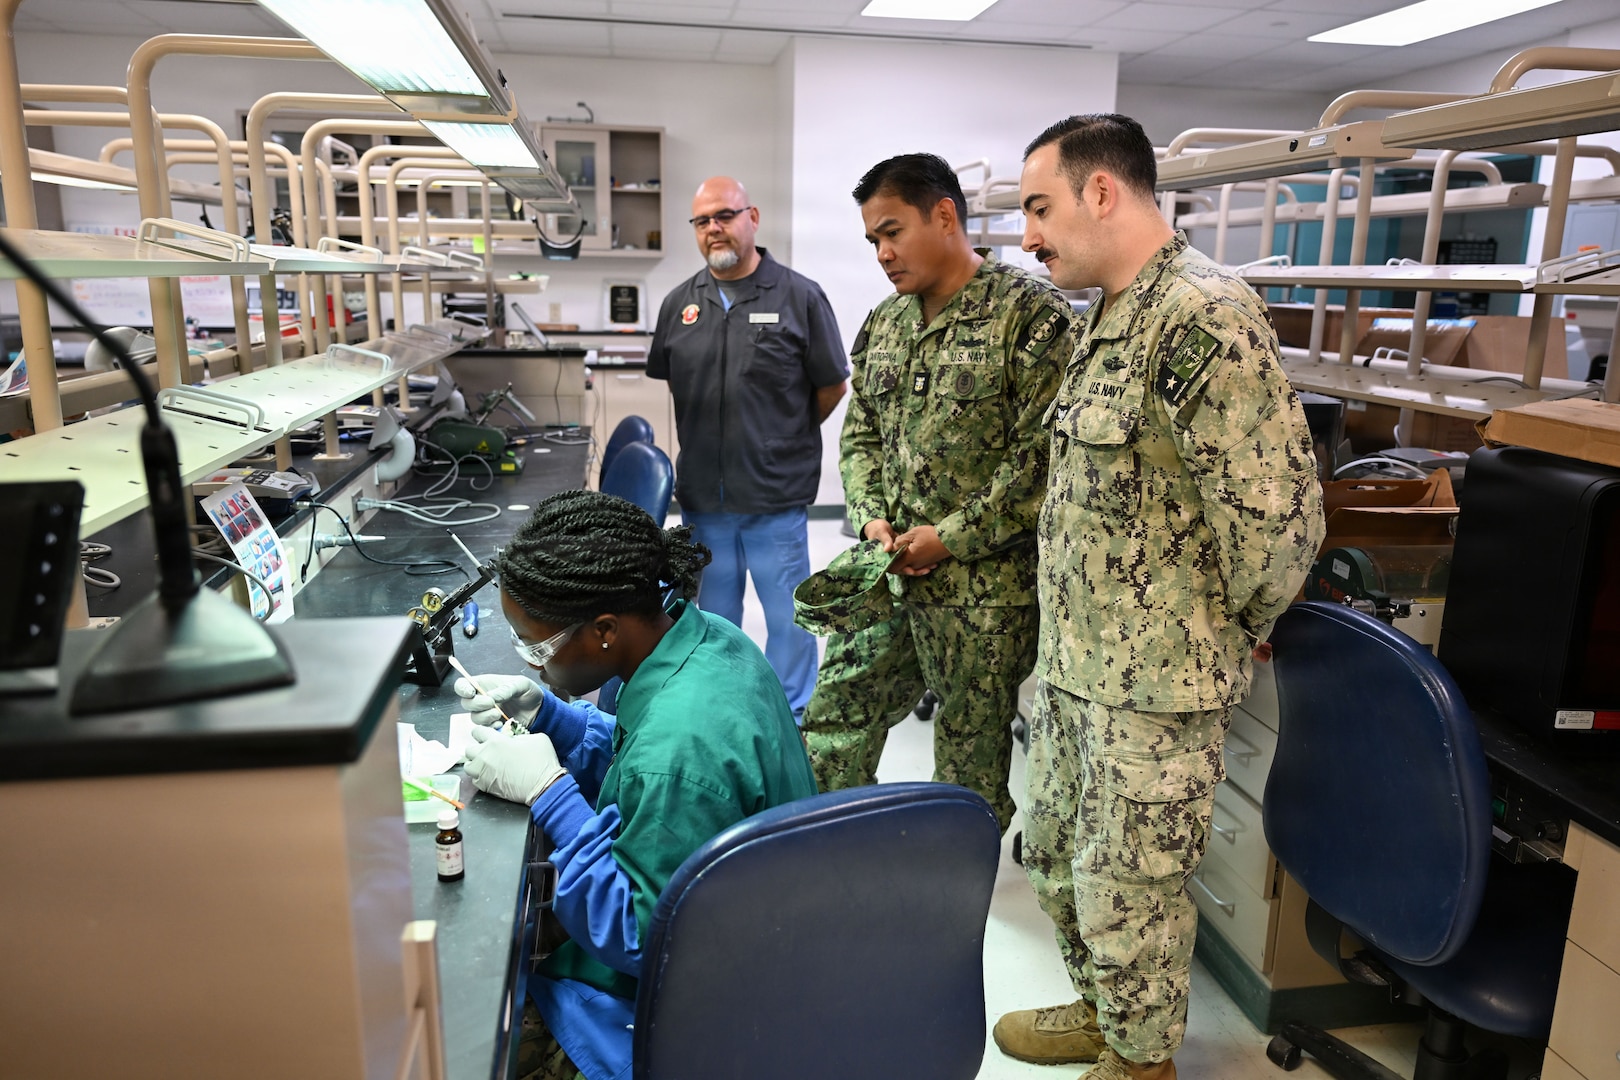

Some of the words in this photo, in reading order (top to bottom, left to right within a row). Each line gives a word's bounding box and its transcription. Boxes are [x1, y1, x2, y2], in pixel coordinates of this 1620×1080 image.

[951, 352, 964, 362] U.S.
[967, 352, 990, 362] NAVY
[1089, 382, 1100, 395] U.S.
[1101, 384, 1126, 399] NAVY
